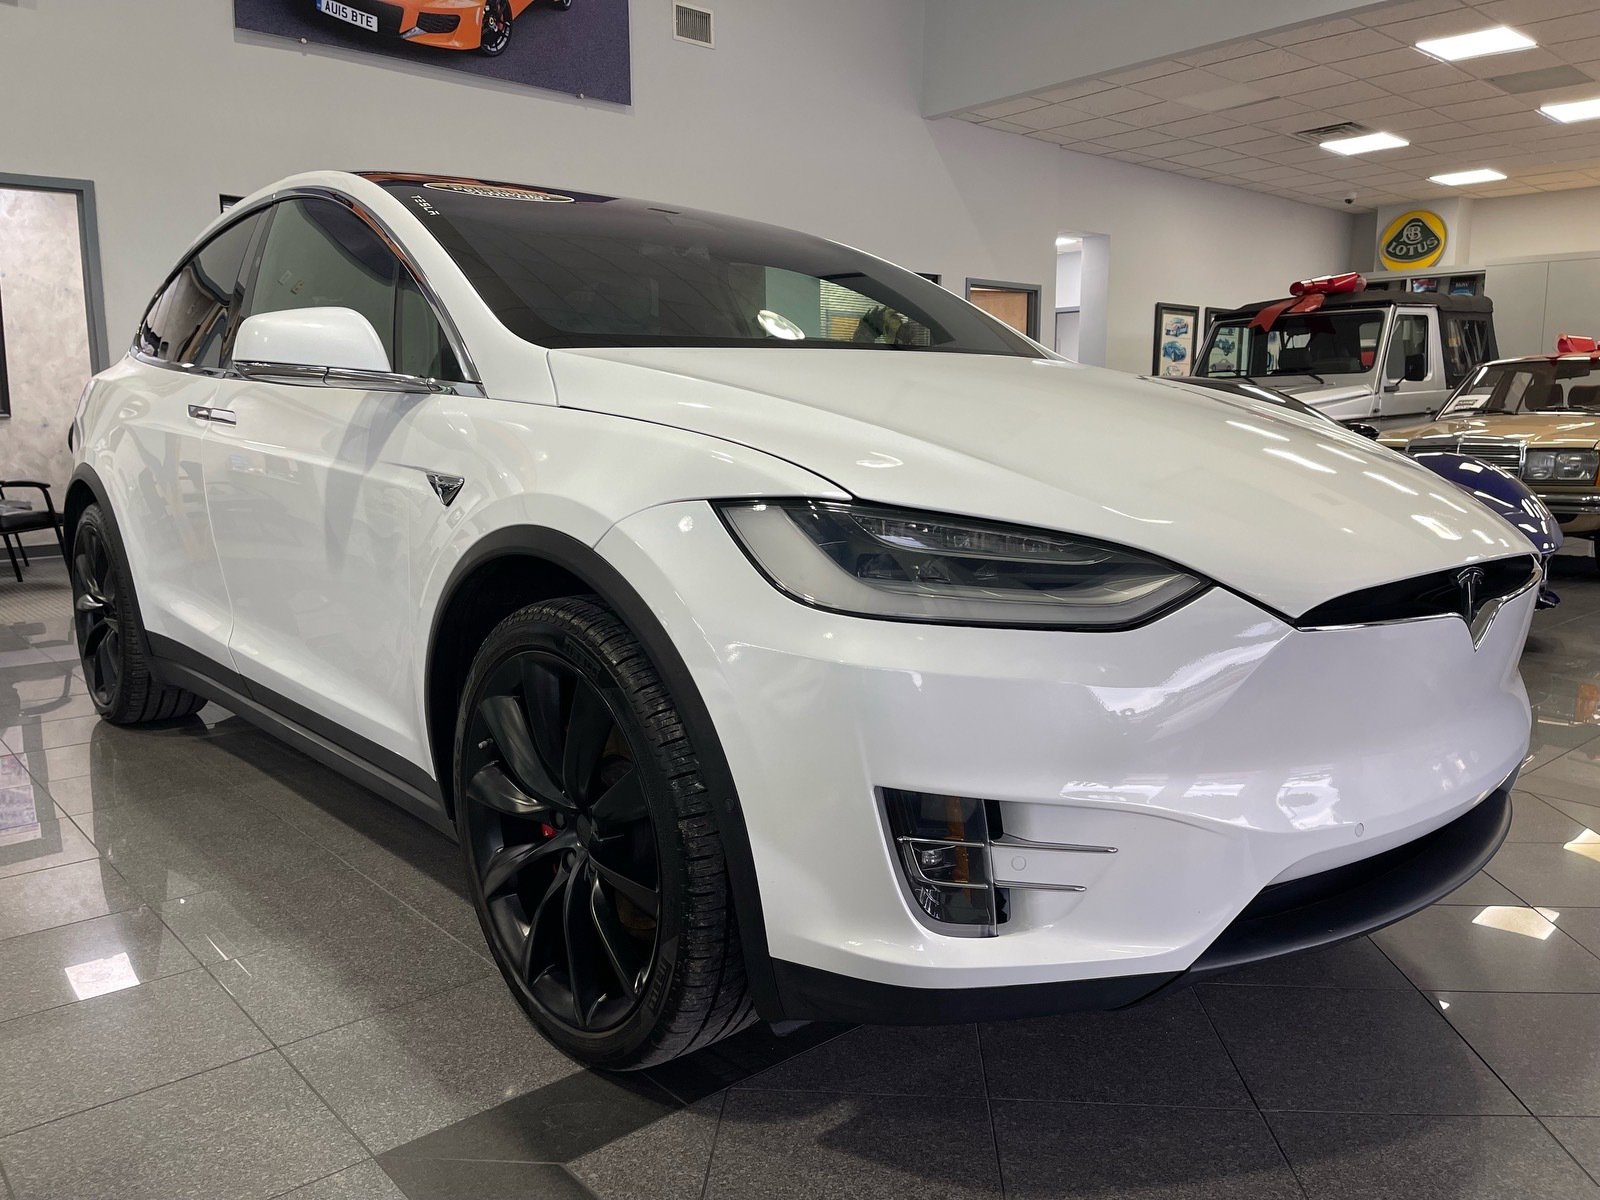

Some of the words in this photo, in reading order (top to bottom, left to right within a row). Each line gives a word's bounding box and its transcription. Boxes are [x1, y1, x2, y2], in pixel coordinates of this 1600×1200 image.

[325, 0, 348, 18] AU15
[351, 10, 373, 28] BTE
[410, 194, 441, 216] TESLA
[1388, 237, 1438, 256] LOTUS
